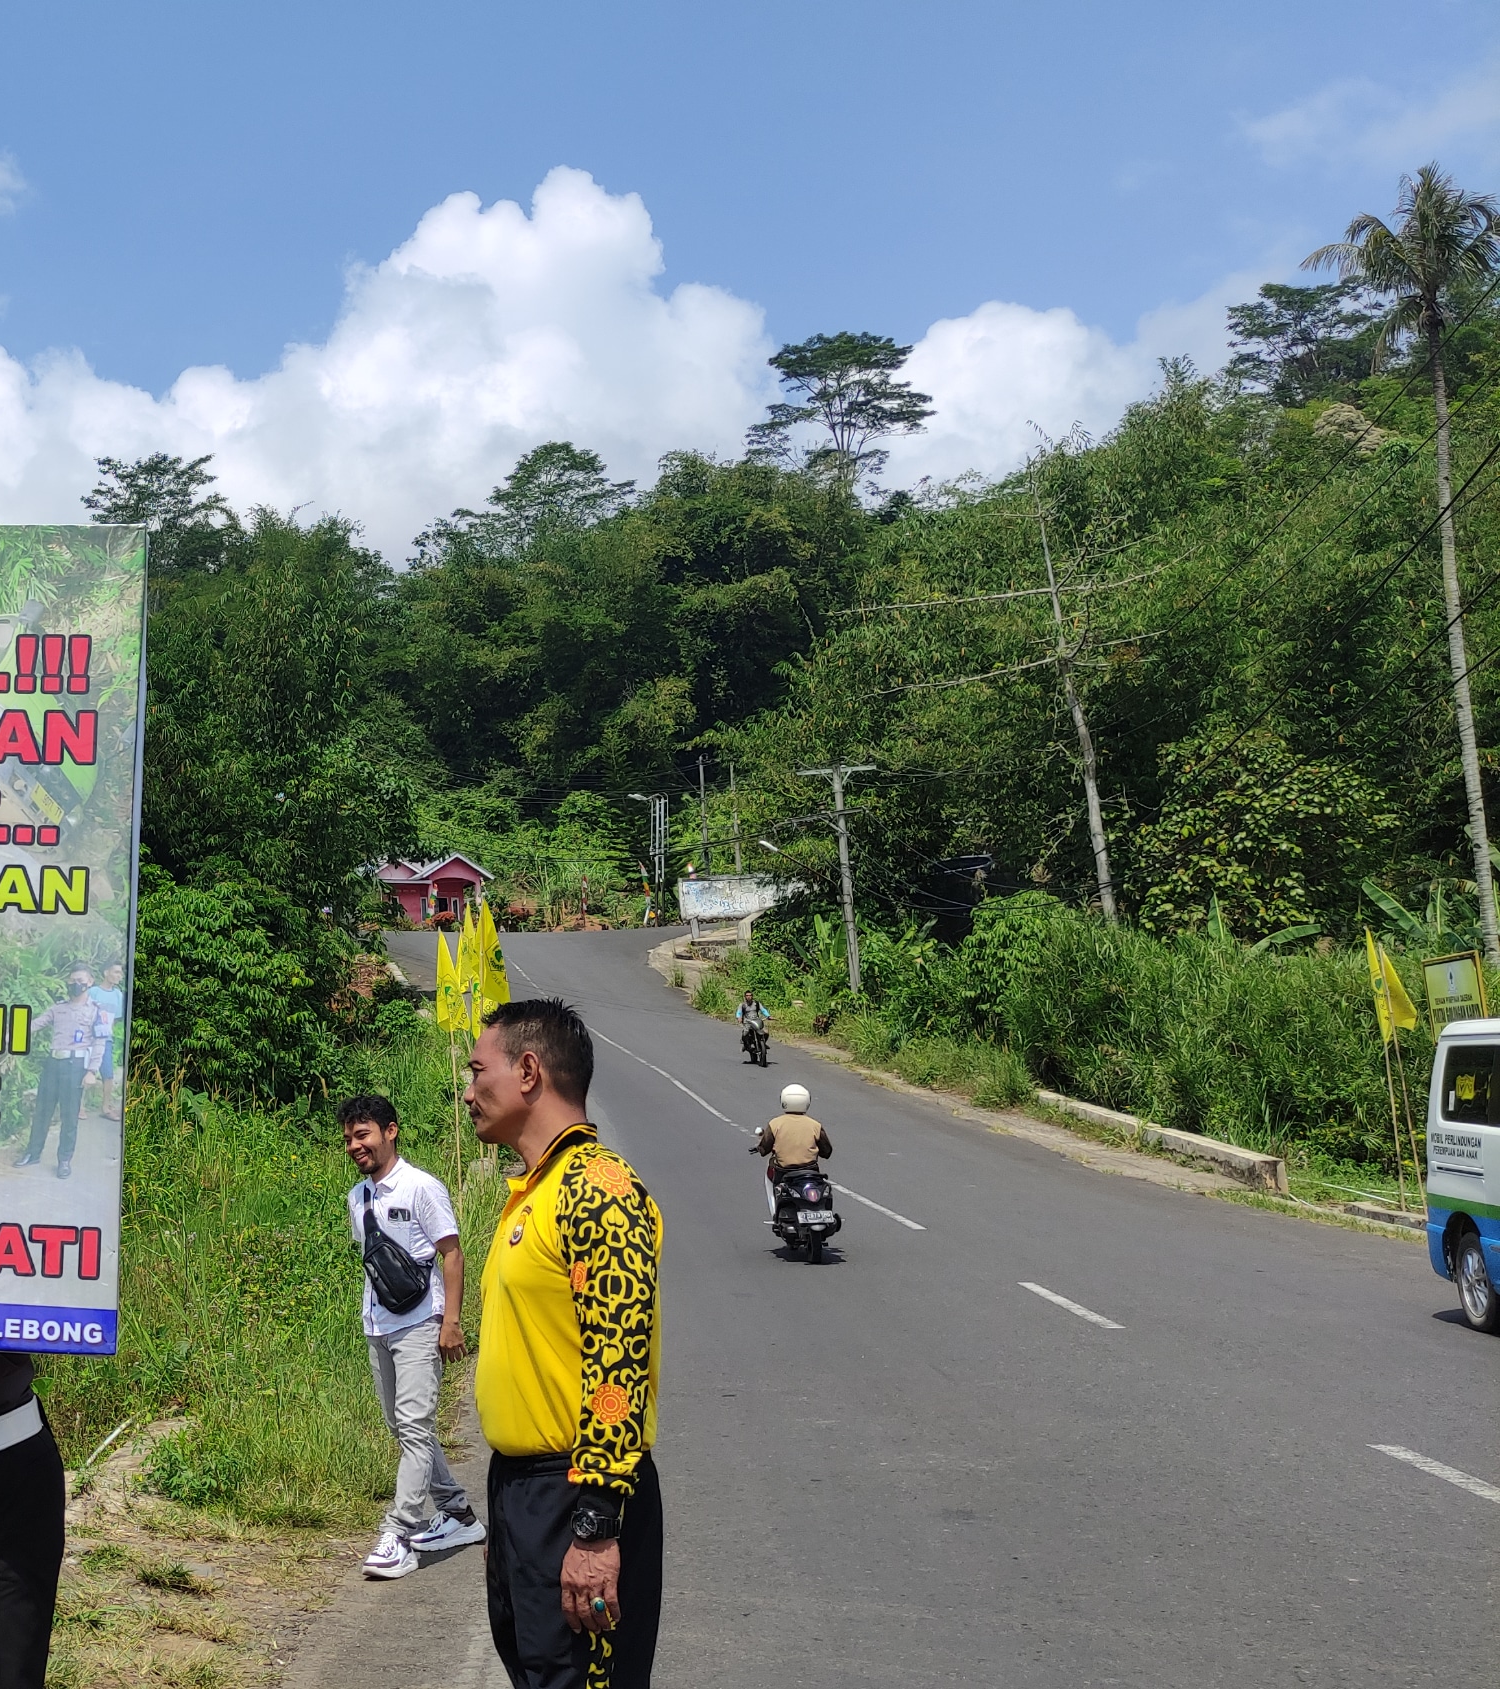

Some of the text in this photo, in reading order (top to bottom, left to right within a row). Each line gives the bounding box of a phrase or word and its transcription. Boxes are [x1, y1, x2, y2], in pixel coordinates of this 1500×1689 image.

[1444, 1134, 1482, 1149] PERLINDUNGAN
[1433, 1145, 1478, 1160] PEREMPUAN DAN ANAK
